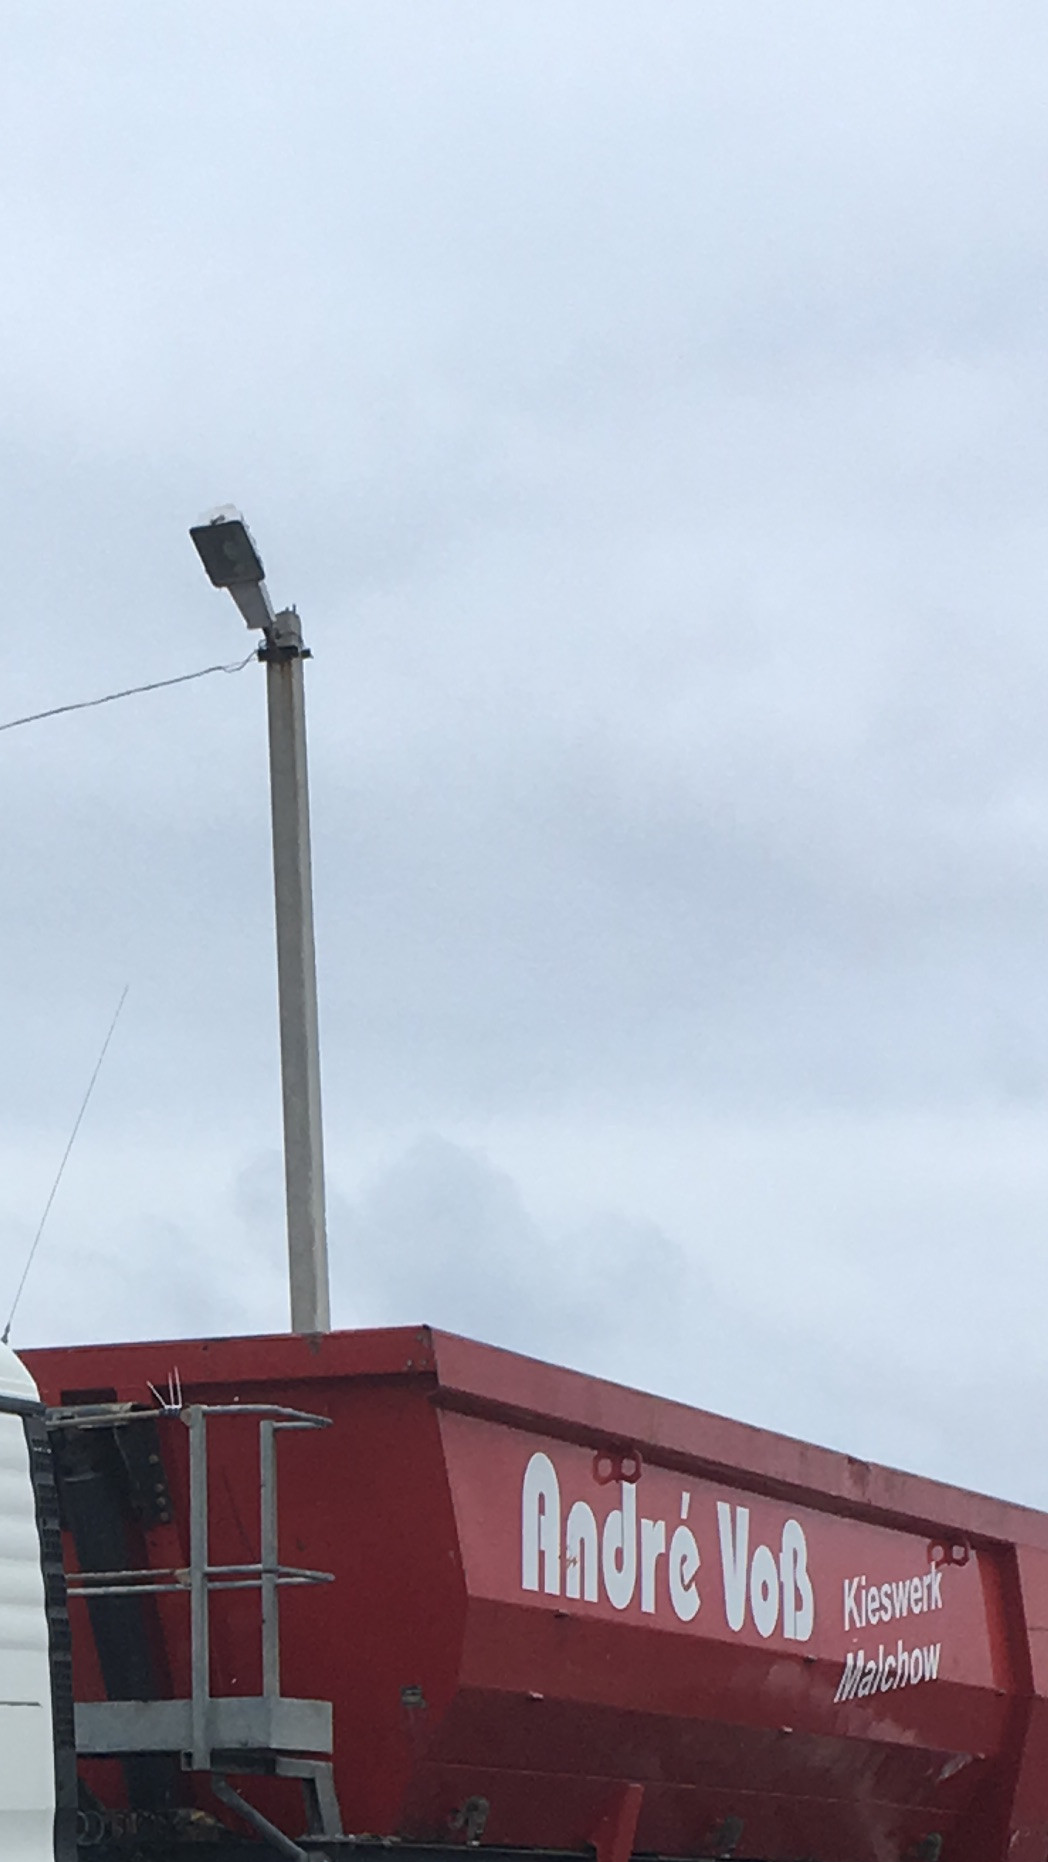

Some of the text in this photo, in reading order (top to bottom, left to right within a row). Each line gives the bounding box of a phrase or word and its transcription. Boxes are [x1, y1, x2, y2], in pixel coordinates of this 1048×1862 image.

[521, 1451, 814, 1642] André Voß
[843, 1560, 944, 1631] Kieswerk
[833, 1639, 942, 1704] Malchow
